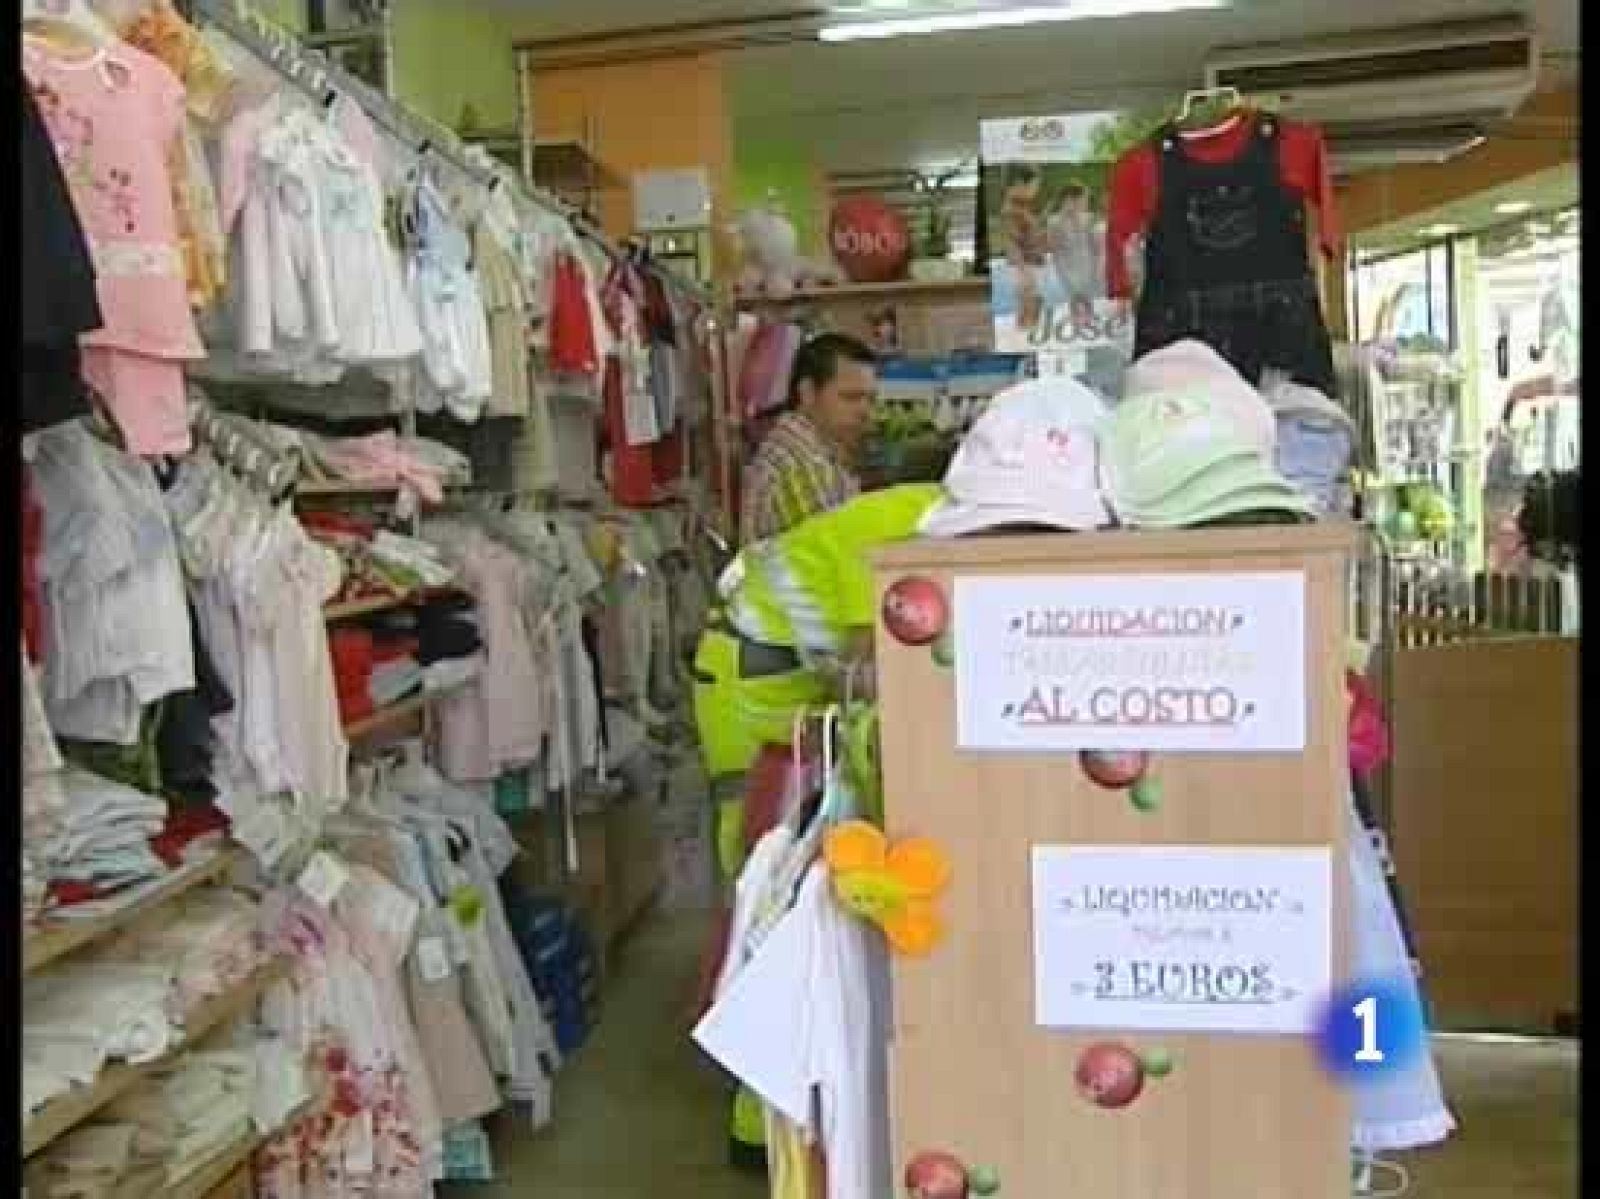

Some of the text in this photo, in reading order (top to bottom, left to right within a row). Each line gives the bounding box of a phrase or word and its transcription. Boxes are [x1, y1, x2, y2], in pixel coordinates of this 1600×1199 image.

[1020, 683, 1238, 726] AL COSTO
[1129, 958, 1275, 1003] EUROS
